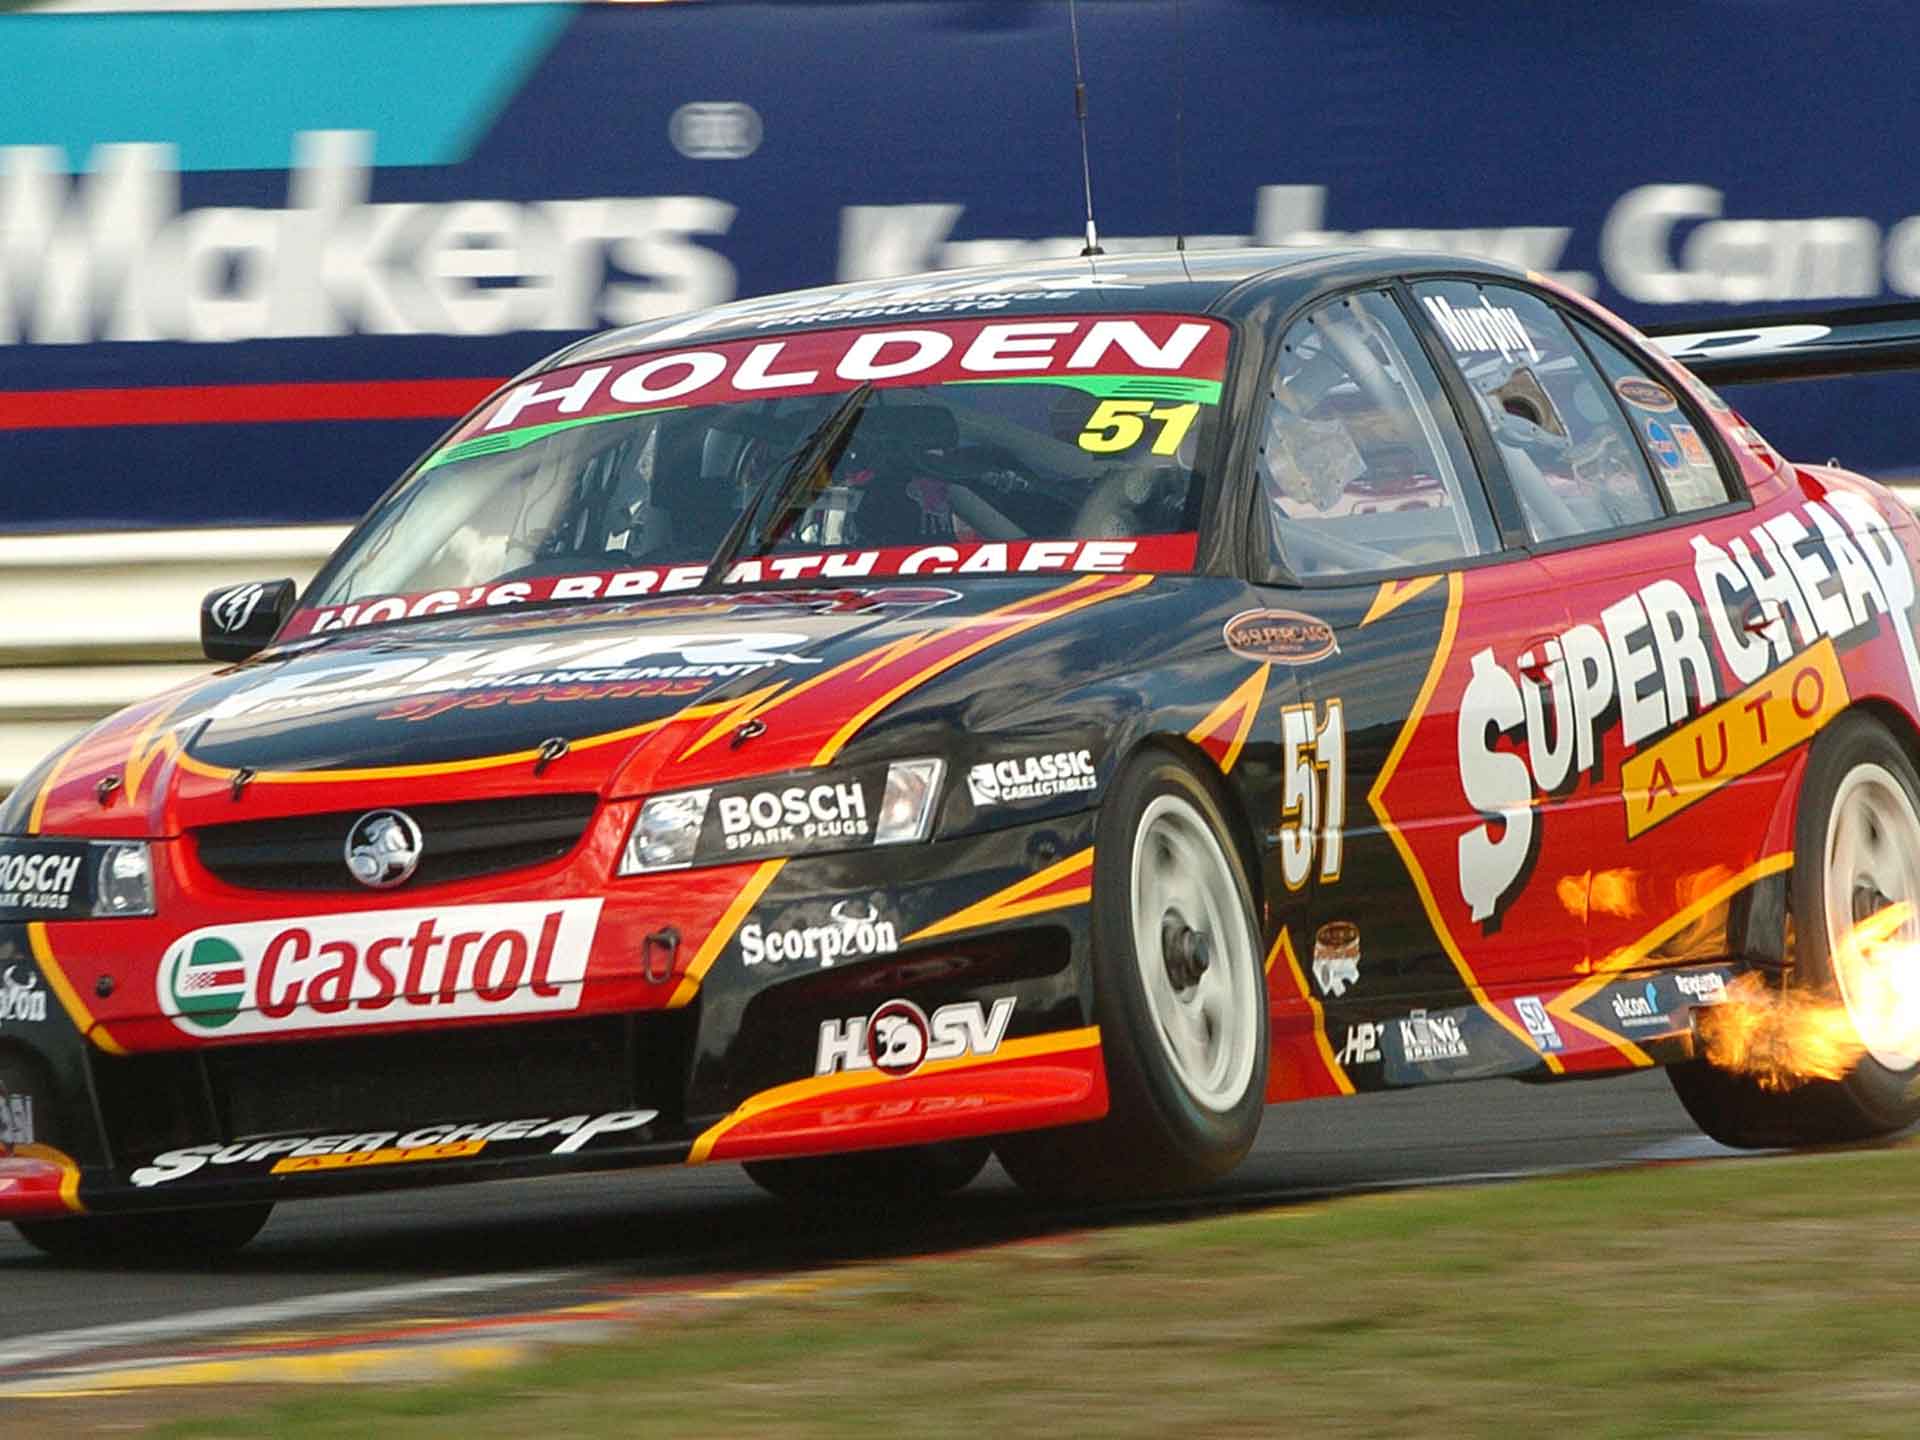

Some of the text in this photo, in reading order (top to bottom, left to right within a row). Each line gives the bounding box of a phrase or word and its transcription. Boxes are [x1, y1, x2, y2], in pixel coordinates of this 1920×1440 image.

[0, 130, 738, 345] Makers
[1424, 295, 1540, 363] Murphy
[485, 320, 1210, 432] HOLDEN
[1078, 400, 1202, 457] 51
[898, 541, 1138, 576] CAFE
[1457, 489, 1920, 923] SUPER CHEAP
[995, 750, 1095, 788] CLASSIC
[1646, 666, 1825, 812] AUTO
[719, 783, 867, 835] BOSCH
[1279, 697, 1345, 892] 51
[724, 818, 869, 850] SPARK PLUGS
[22, 892, 70, 910] PLUGS
[255, 910, 564, 1018] Castrol
[740, 906, 898, 967] Scorpion
[130, 1109, 659, 1187] SUPER CHEAP
[297, 1142, 475, 1167] AUTO
